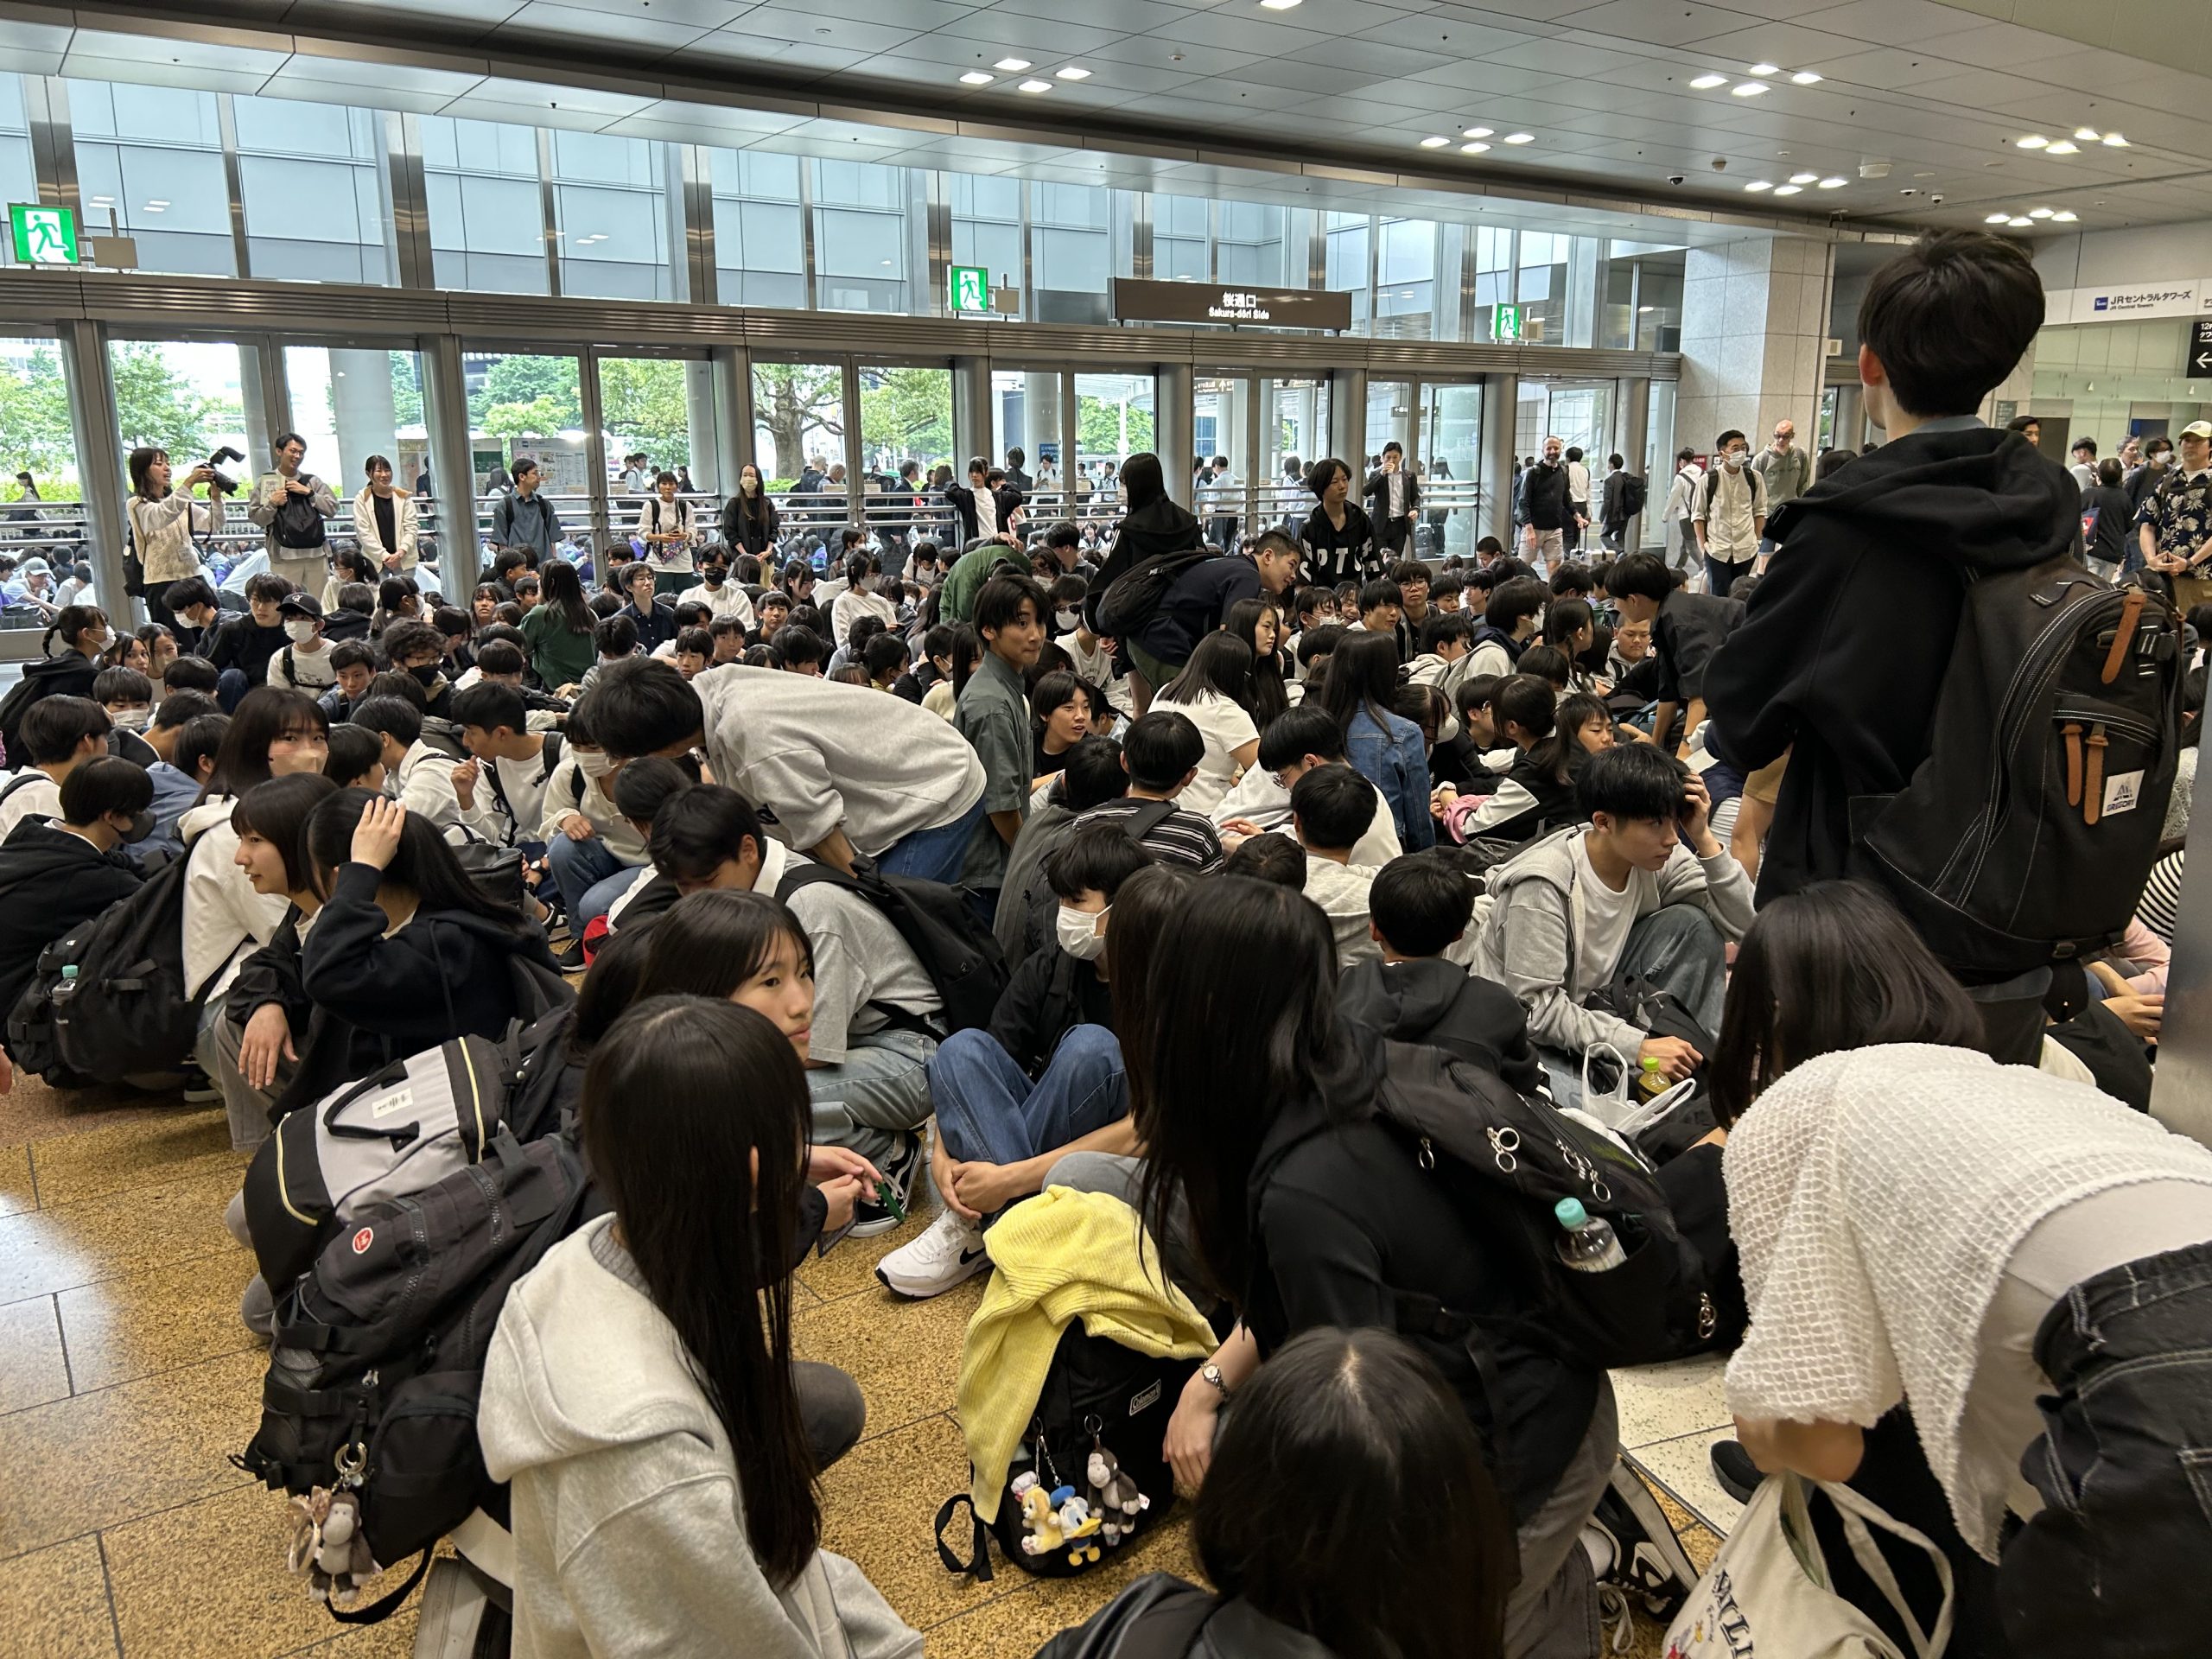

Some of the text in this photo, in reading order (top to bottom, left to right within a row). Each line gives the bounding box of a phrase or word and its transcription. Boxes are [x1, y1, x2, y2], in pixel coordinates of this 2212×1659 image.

[1223, 290, 1256, 308] 桜通口
[2110, 289, 2192, 305] JRセントラルタワーズ
[1252, 308, 1270, 321] Side
